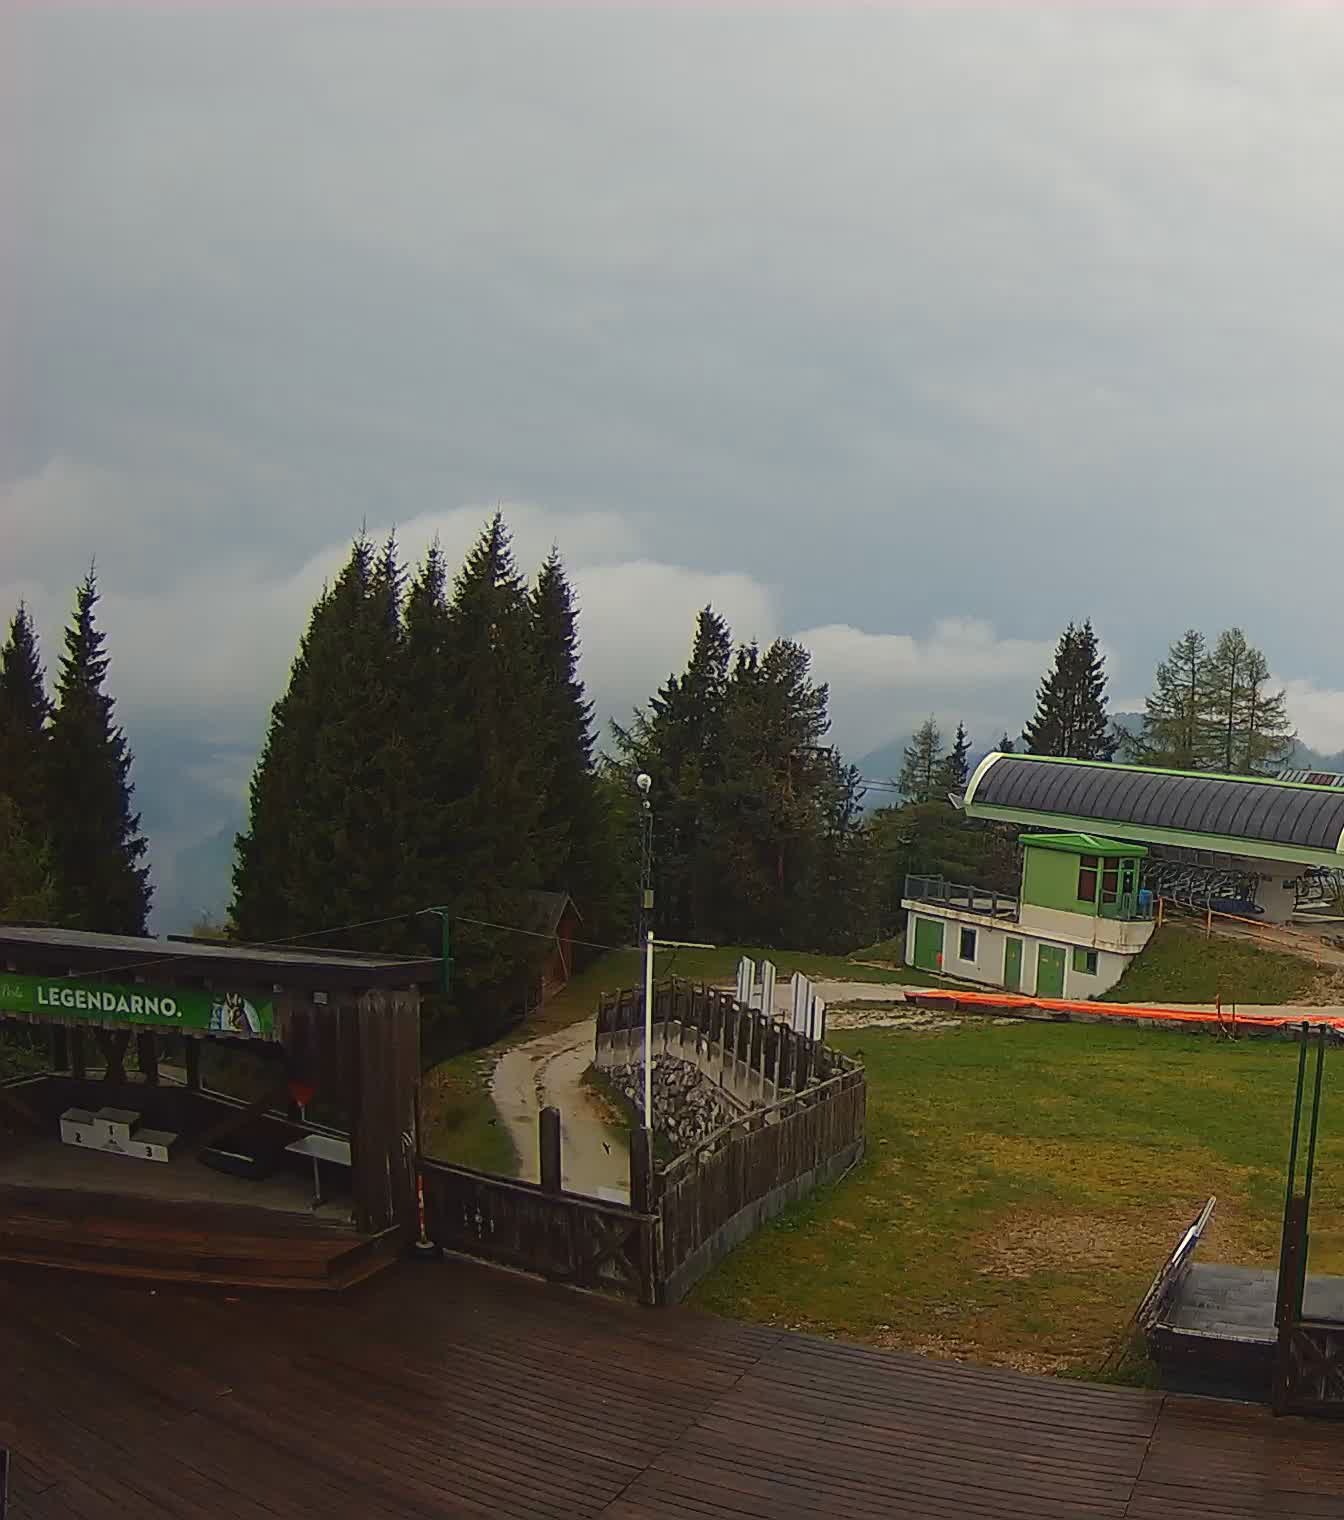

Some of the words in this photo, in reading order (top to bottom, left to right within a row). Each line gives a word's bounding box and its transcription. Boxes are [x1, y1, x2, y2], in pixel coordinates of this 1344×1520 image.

[37, 985, 183, 1018] LEGENDARNO.
[75, 1132, 83, 1143] 2
[145, 1146, 153, 1157] 3
